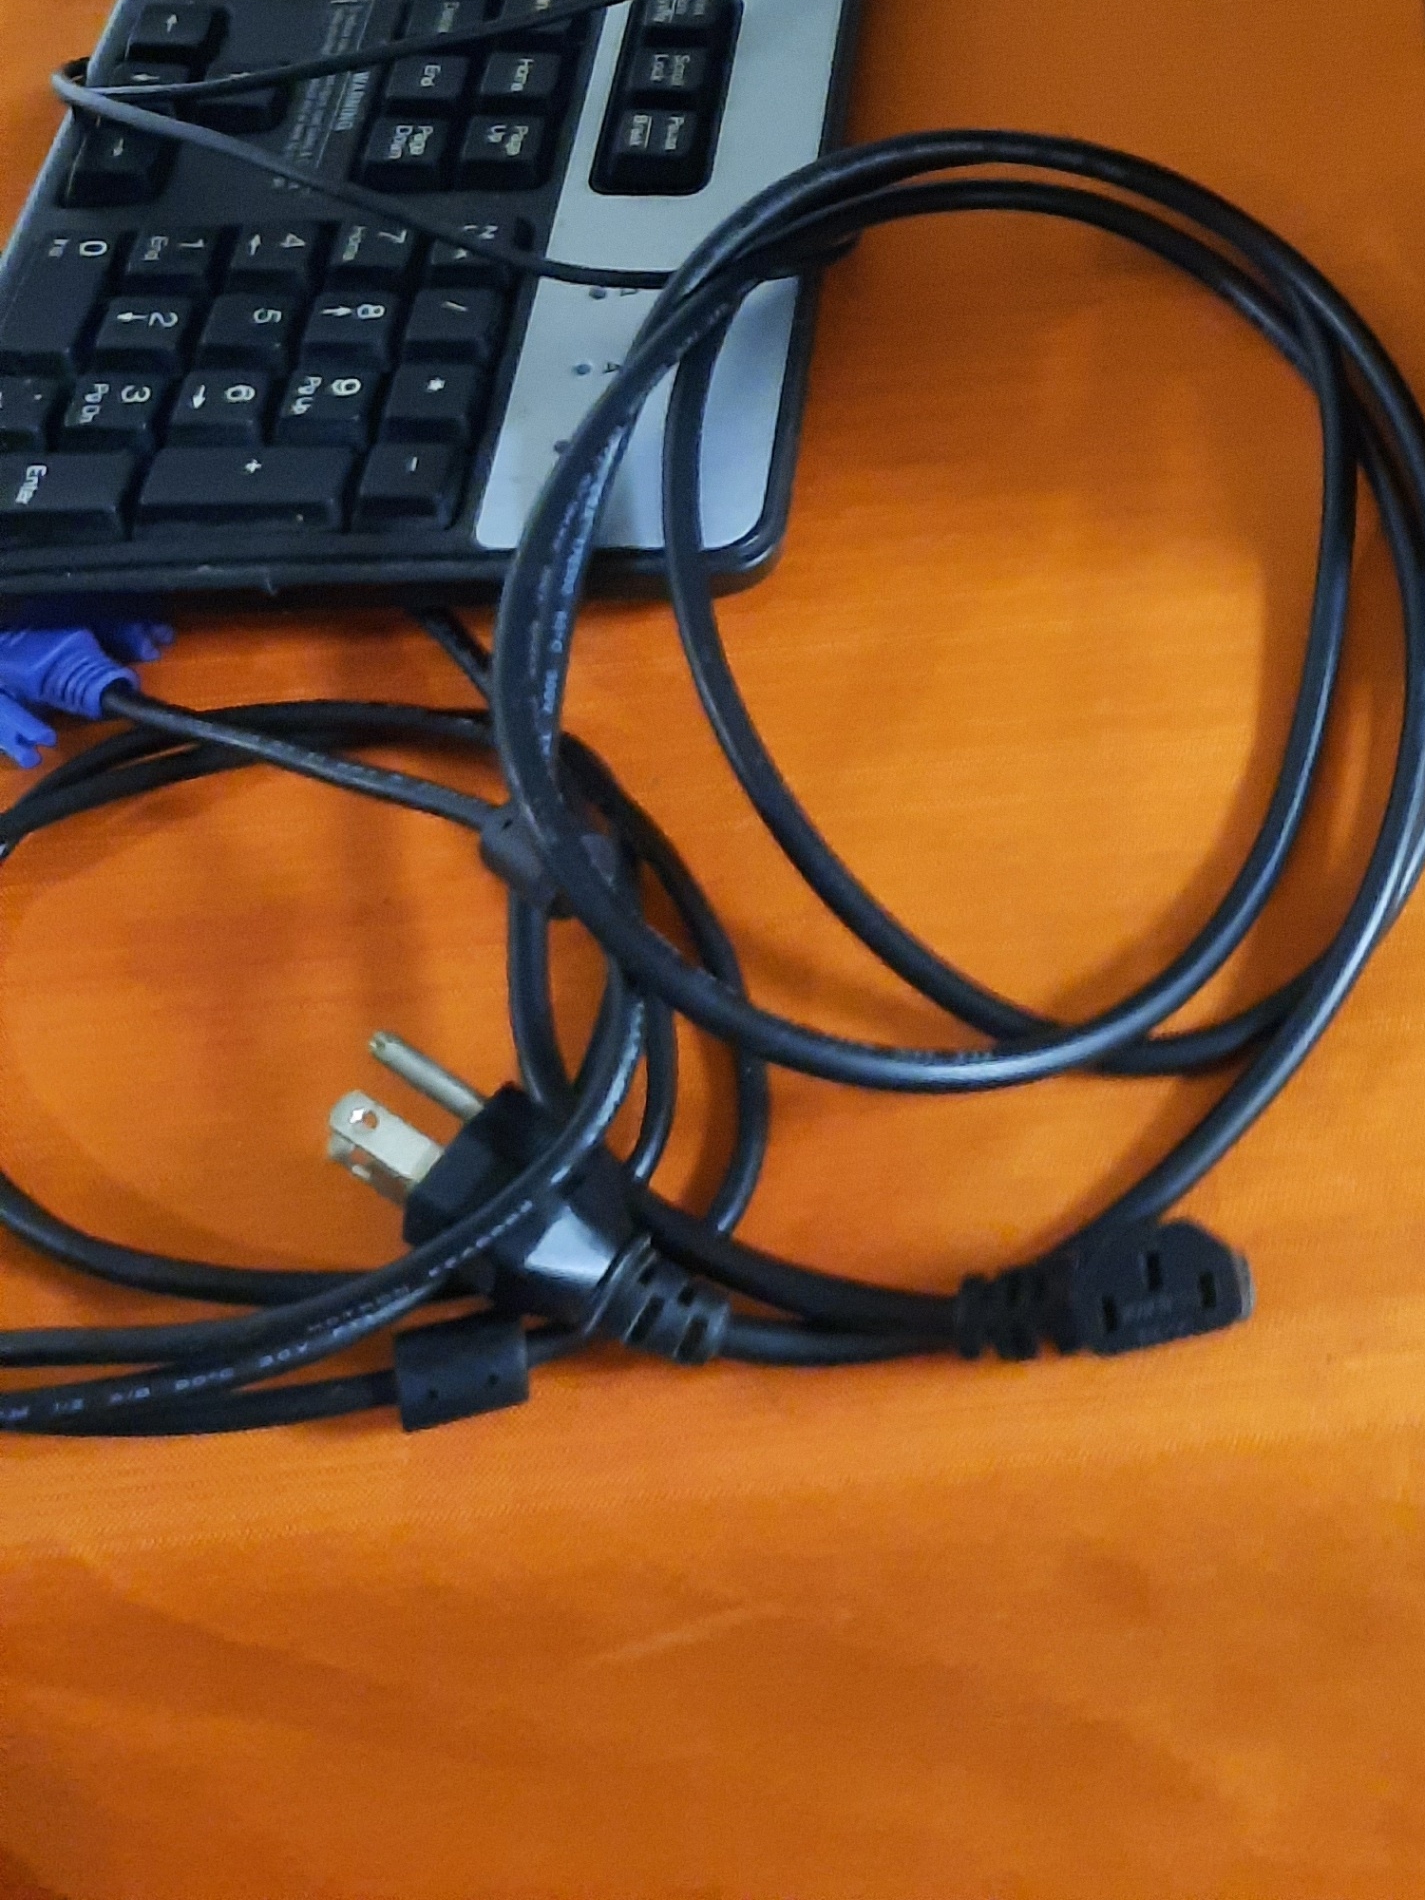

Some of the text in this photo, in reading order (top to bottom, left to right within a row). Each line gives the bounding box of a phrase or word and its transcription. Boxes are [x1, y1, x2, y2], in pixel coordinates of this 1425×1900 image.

[420, 64, 442, 87] End
[510, 58, 535, 92] Home
[387, 124, 414, 160] Down
[409, 124, 434, 156] Page
[487, 124, 507, 143] Up
[505, 124, 529, 156] Page
[176, 238, 205, 249] 1
[279, 232, 307, 249] 4
[378, 229, 408, 244] 7
[78, 239, 108, 258] 0
[142, 235, 169, 262] End
[148, 311, 179, 329] 2
[252, 307, 283, 324] 5
[356, 303, 386, 320] 8
[120, 384, 151, 404] 3
[224, 383, 256, 403] 6
[330, 377, 362, 397] 9
[14, 464, 48, 505] Enter
